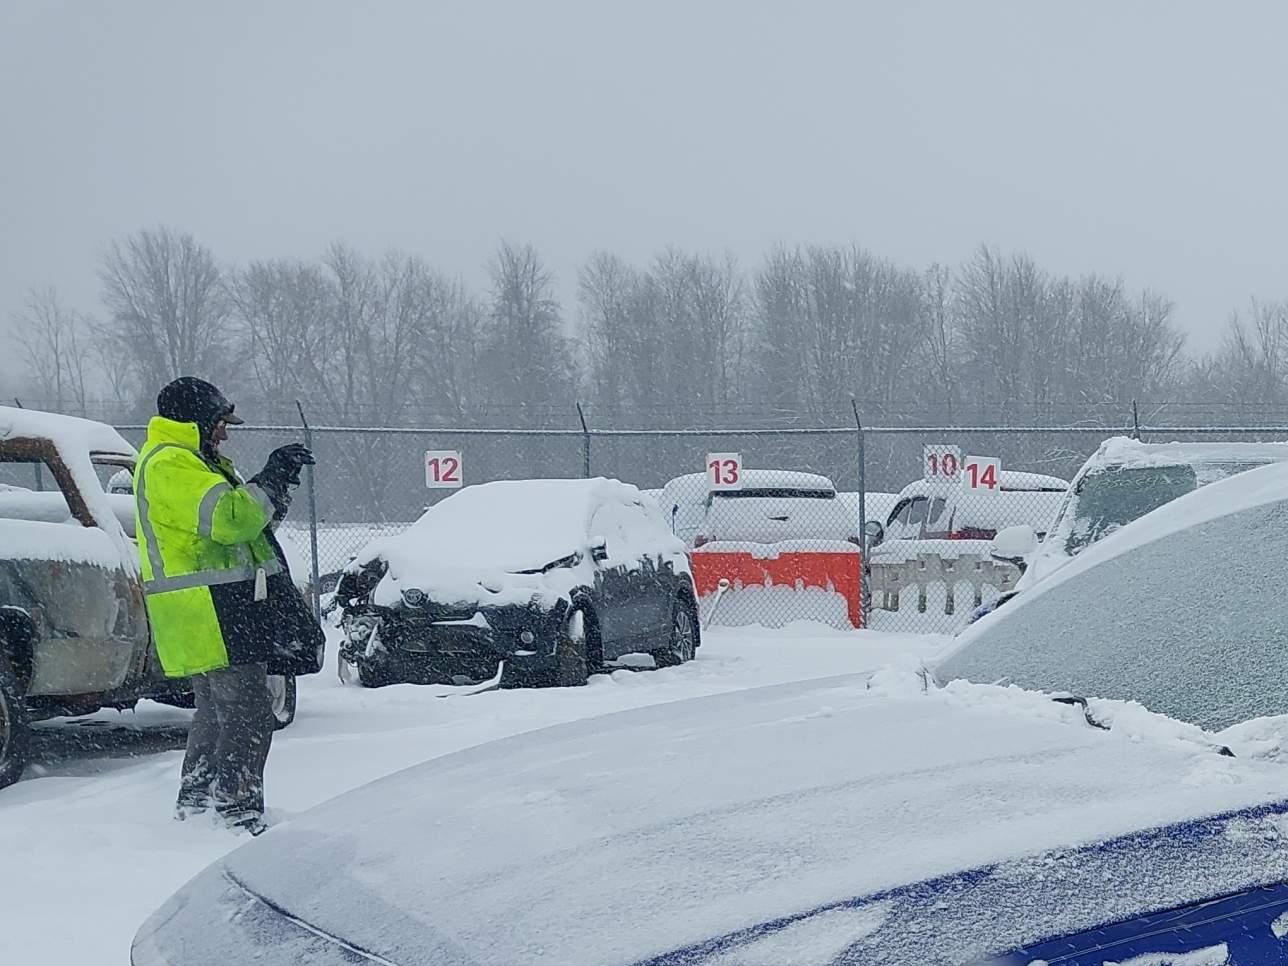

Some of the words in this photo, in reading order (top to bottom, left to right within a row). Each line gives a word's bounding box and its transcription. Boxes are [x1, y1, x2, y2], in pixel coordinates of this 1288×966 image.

[428, 458, 459, 482] 12
[709, 459, 739, 484] 13
[927, 453, 957, 476] 10
[966, 463, 998, 490] 14
